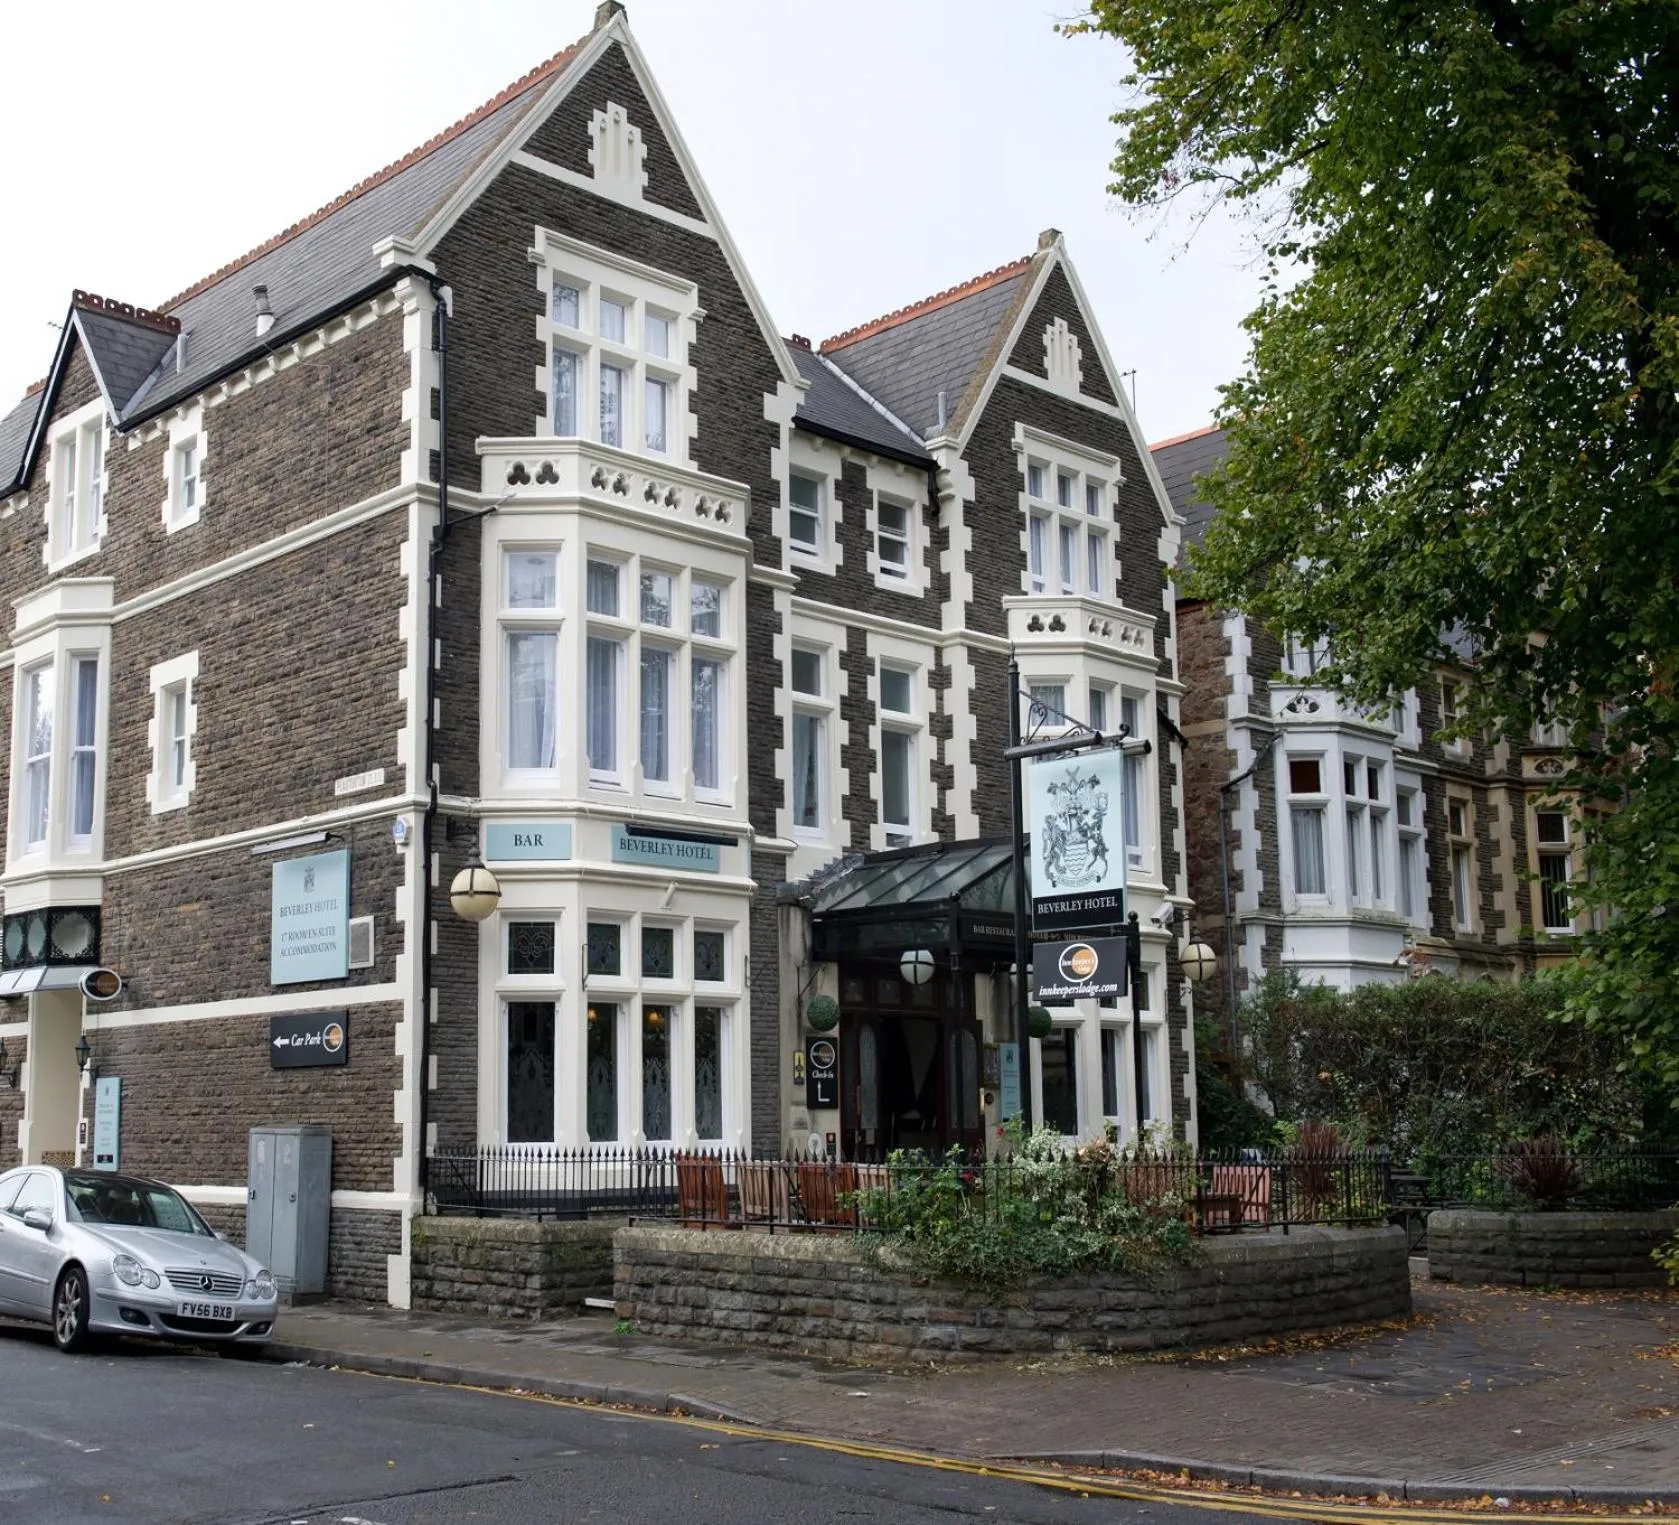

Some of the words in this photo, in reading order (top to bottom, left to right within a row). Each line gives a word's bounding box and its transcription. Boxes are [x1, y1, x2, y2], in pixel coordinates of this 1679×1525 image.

[513, 833, 544, 847] BAR
[619, 838, 675, 856] BEVERLEY
[676, 843, 713, 860] HOTEL
[280, 903, 313, 917] BEVERLEY
[314, 899, 338, 912] HOTEL
[1037, 900, 1085, 914] BEVERLEY
[1085, 896, 1118, 909] HOTEL
[280, 942, 337, 957] ACCOMMODATION
[1039, 981, 1118, 998] innkeeperslodge.com
[291, 1033, 304, 1047] Car
[304, 1031, 321, 1046] Park
[182, 1302, 211, 1317] FV56
